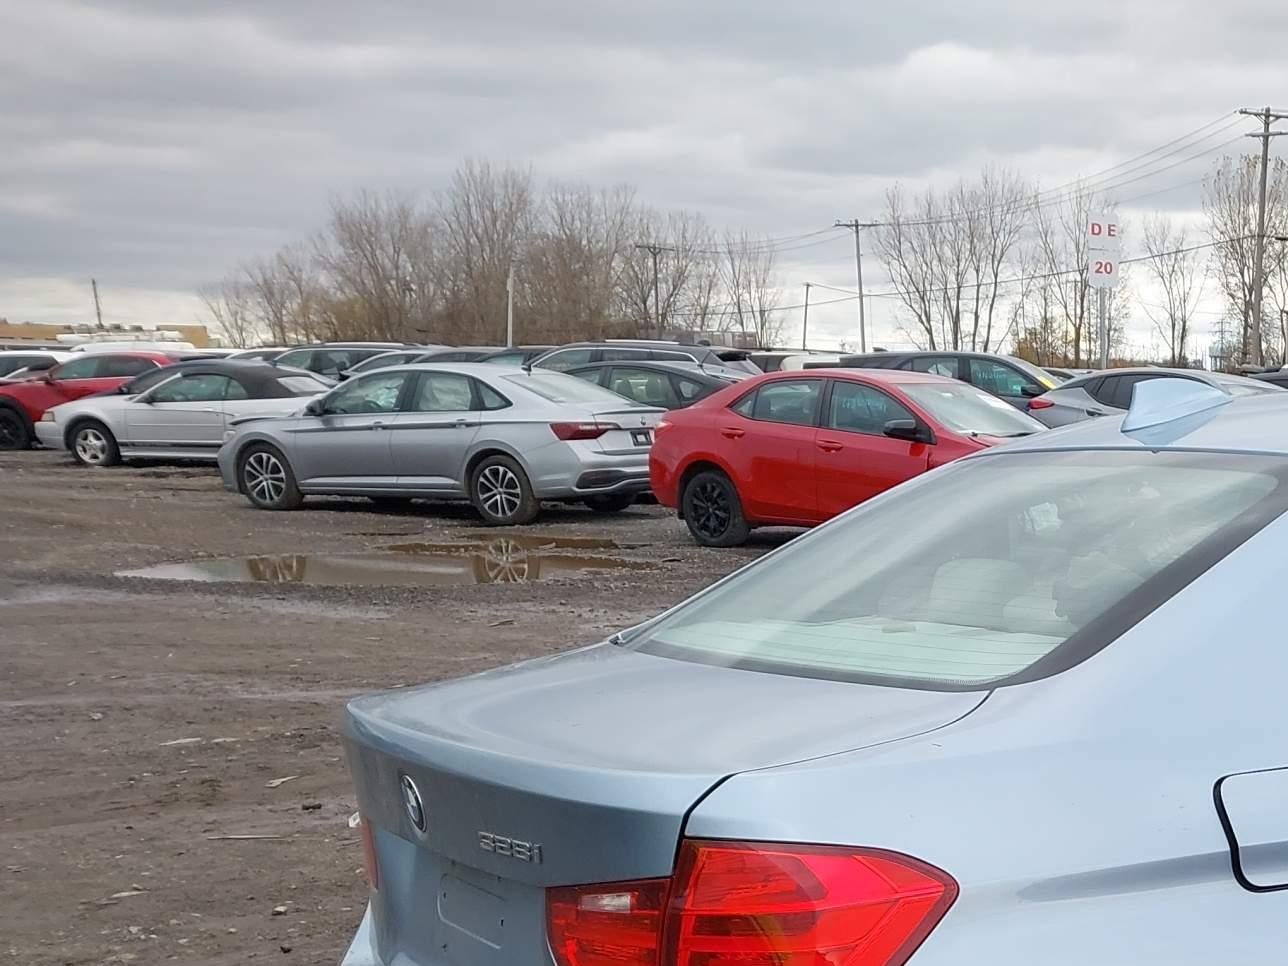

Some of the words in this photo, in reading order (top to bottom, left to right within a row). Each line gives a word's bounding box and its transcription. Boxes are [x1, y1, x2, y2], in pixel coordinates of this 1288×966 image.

[1091, 223, 1102, 236] D
[1107, 223, 1116, 237] E
[1094, 261, 1113, 275] 20
